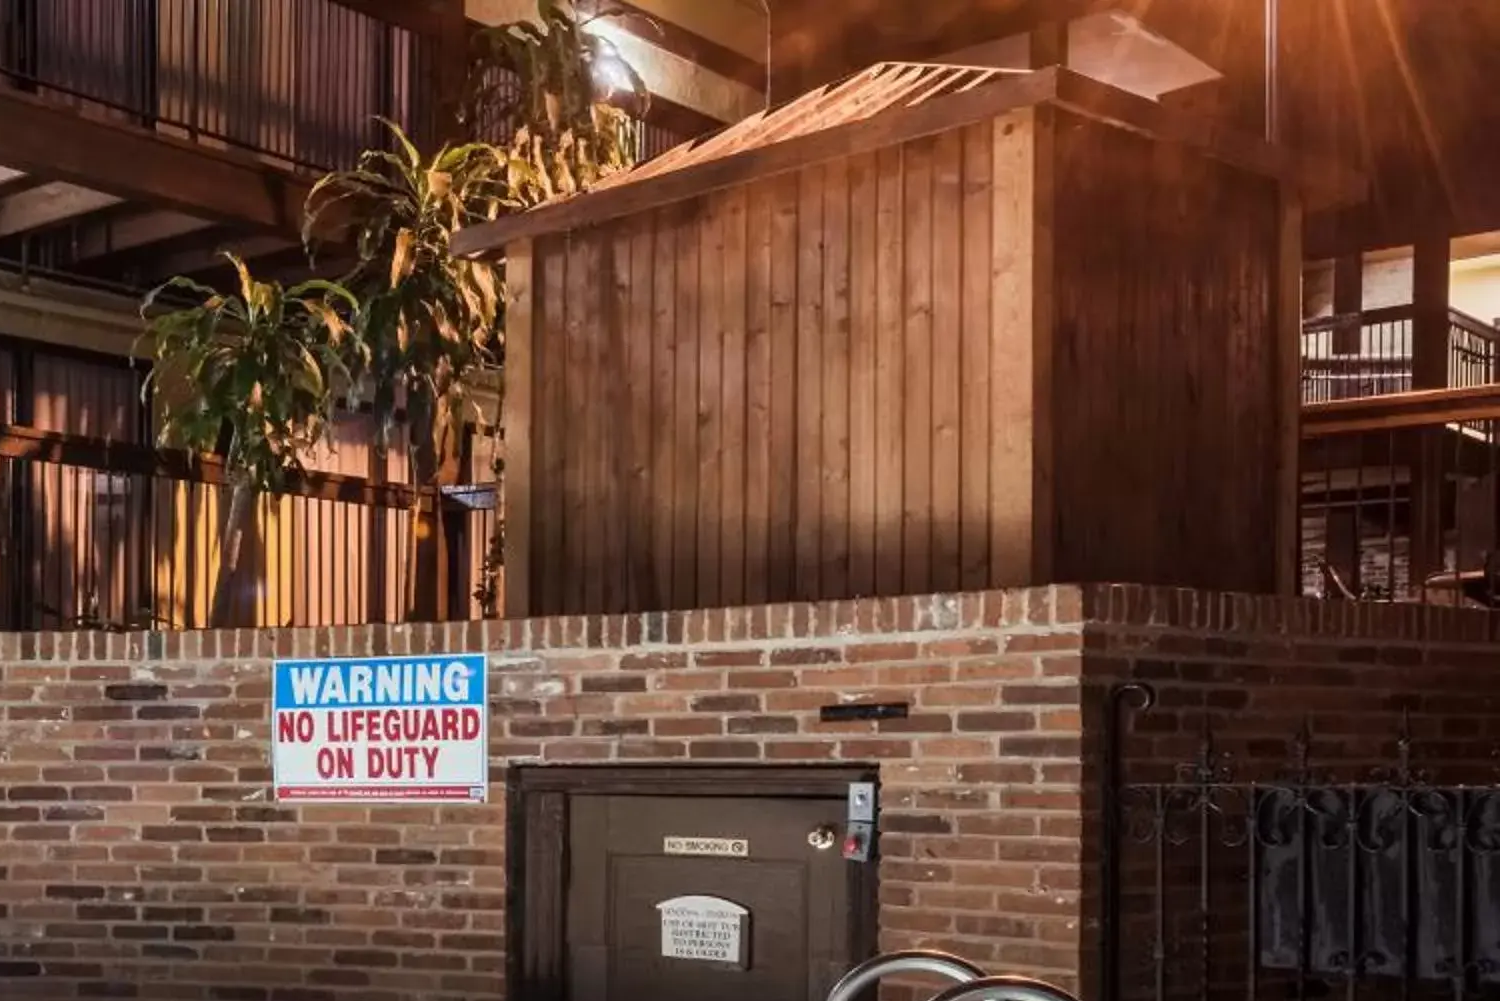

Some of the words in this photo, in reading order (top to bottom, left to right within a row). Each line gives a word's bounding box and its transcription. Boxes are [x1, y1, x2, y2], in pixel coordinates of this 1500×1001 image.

[289, 662, 470, 705] WARNING
[278, 710, 315, 743] NO
[327, 708, 480, 743] LIFEGUARD
[317, 747, 354, 780] ON
[367, 747, 439, 780] DUTY
